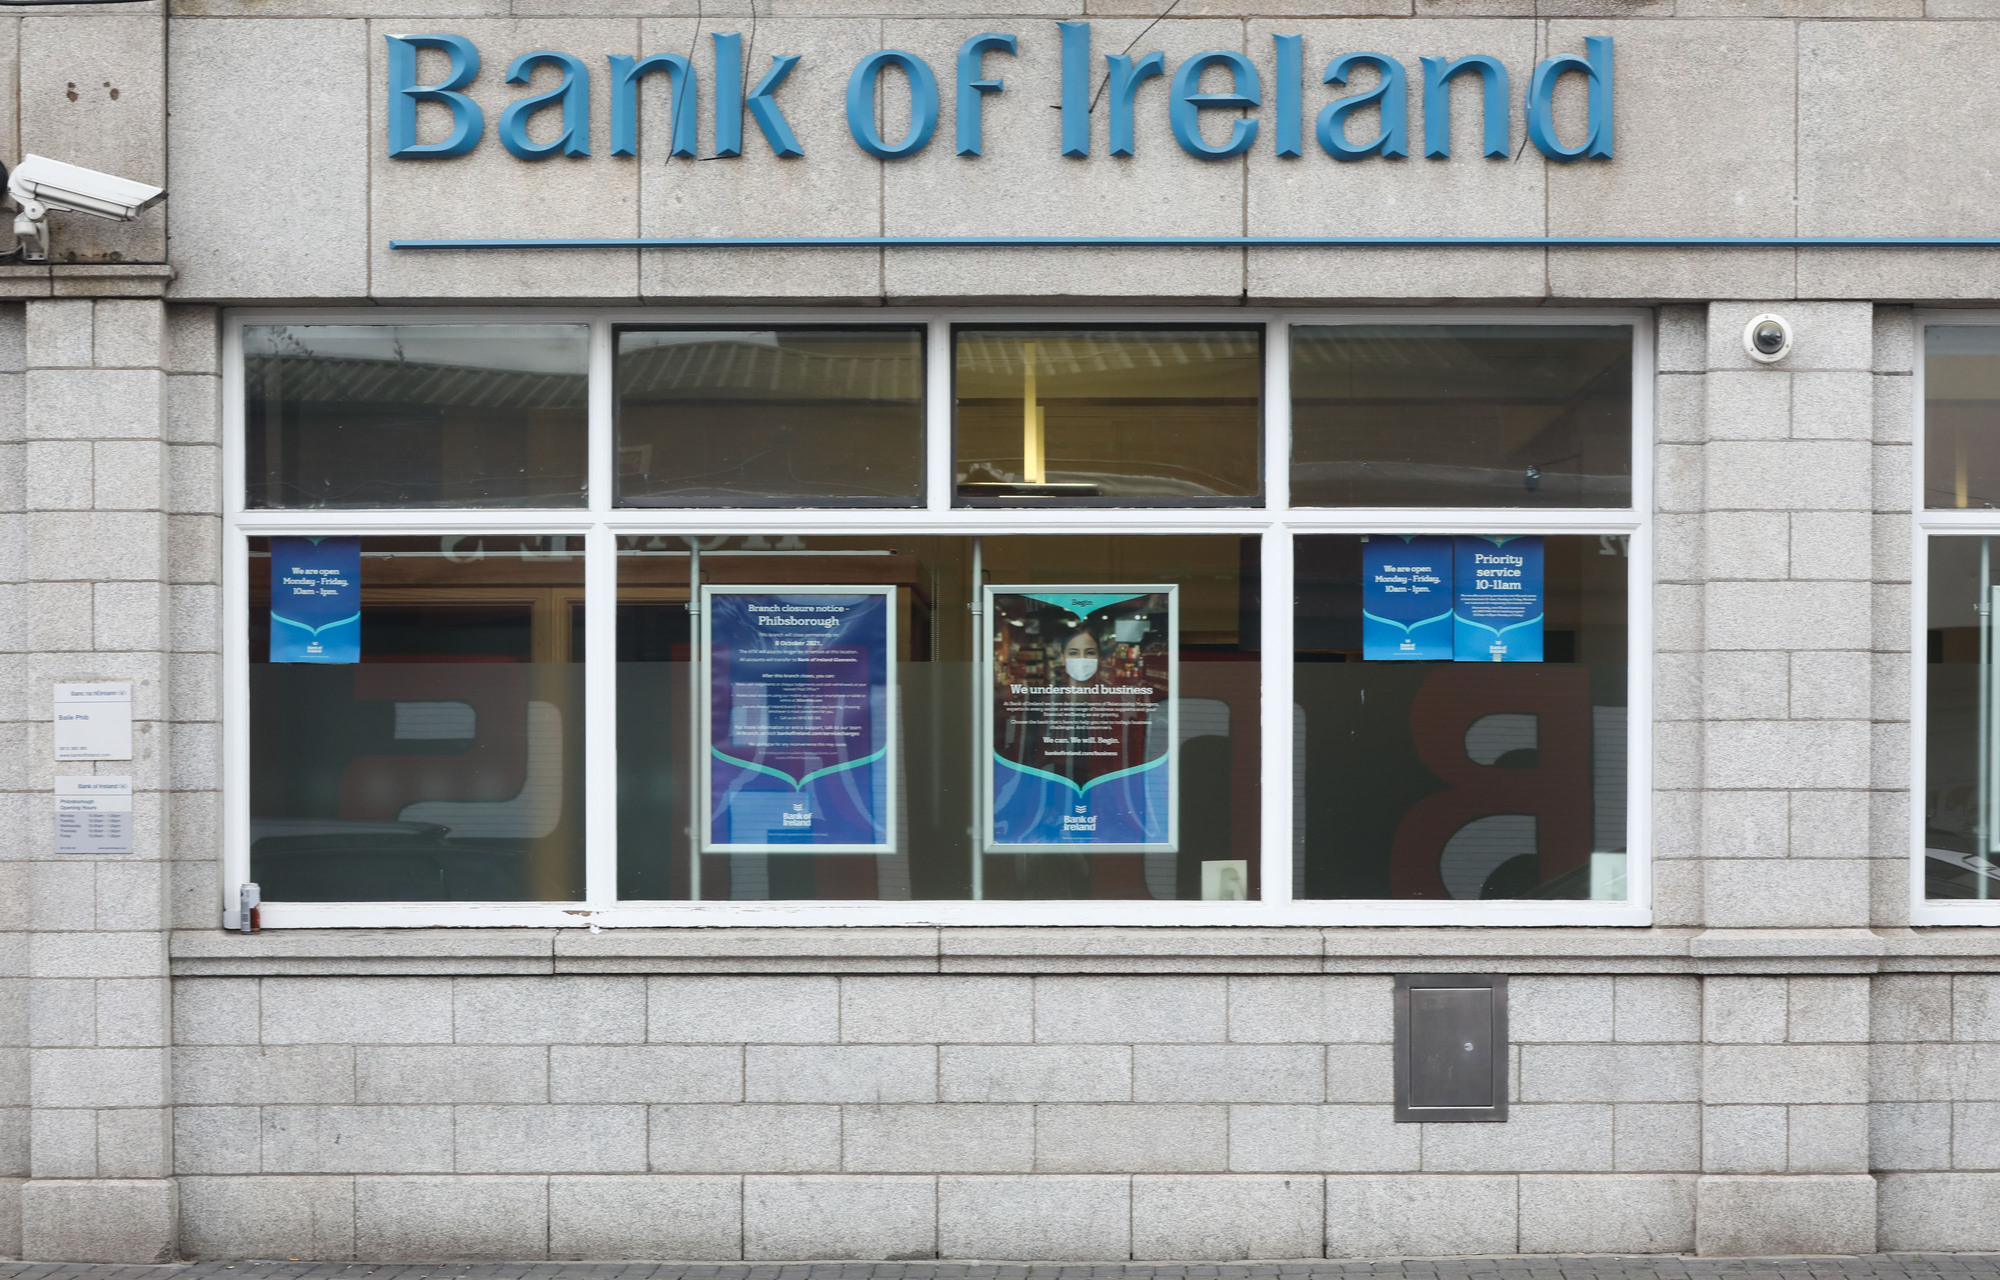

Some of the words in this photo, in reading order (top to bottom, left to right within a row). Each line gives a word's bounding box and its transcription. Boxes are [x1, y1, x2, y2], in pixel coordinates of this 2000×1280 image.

[384, 33, 804, 160] Bank
[846, 33, 1017, 160] of
[1055, 22, 1613, 162] Ireland
[1475, 554, 1523, 567] Priority
[292, 567, 304, 575] We
[319, 569, 340, 577] open
[1476, 567, 1522, 577] service
[283, 577, 316, 587] Monday
[1374, 575, 1408, 584] Monday
[1476, 579, 1522, 590] 10-11am
[293, 587, 315, 595] 10am
[1072, 598, 1093, 607] Begin
[748, 604, 781, 612] Branch
[782, 604, 815, 612] closure
[816, 604, 845, 612] notice
[758, 616, 840, 628] Phibsborough
[1010, 684, 1029, 694] We
[1029, 684, 1100, 695] understand
[1100, 684, 1154, 695] business
[1097, 737, 1120, 745] Begin.
[783, 812, 803, 820] Bank
[803, 812, 813, 820] of
[1064, 815, 1087, 824] Bank
[1087, 815, 1098, 824] of
[783, 819, 812, 827] Ireland
[1064, 823, 1096, 831] Ireland
